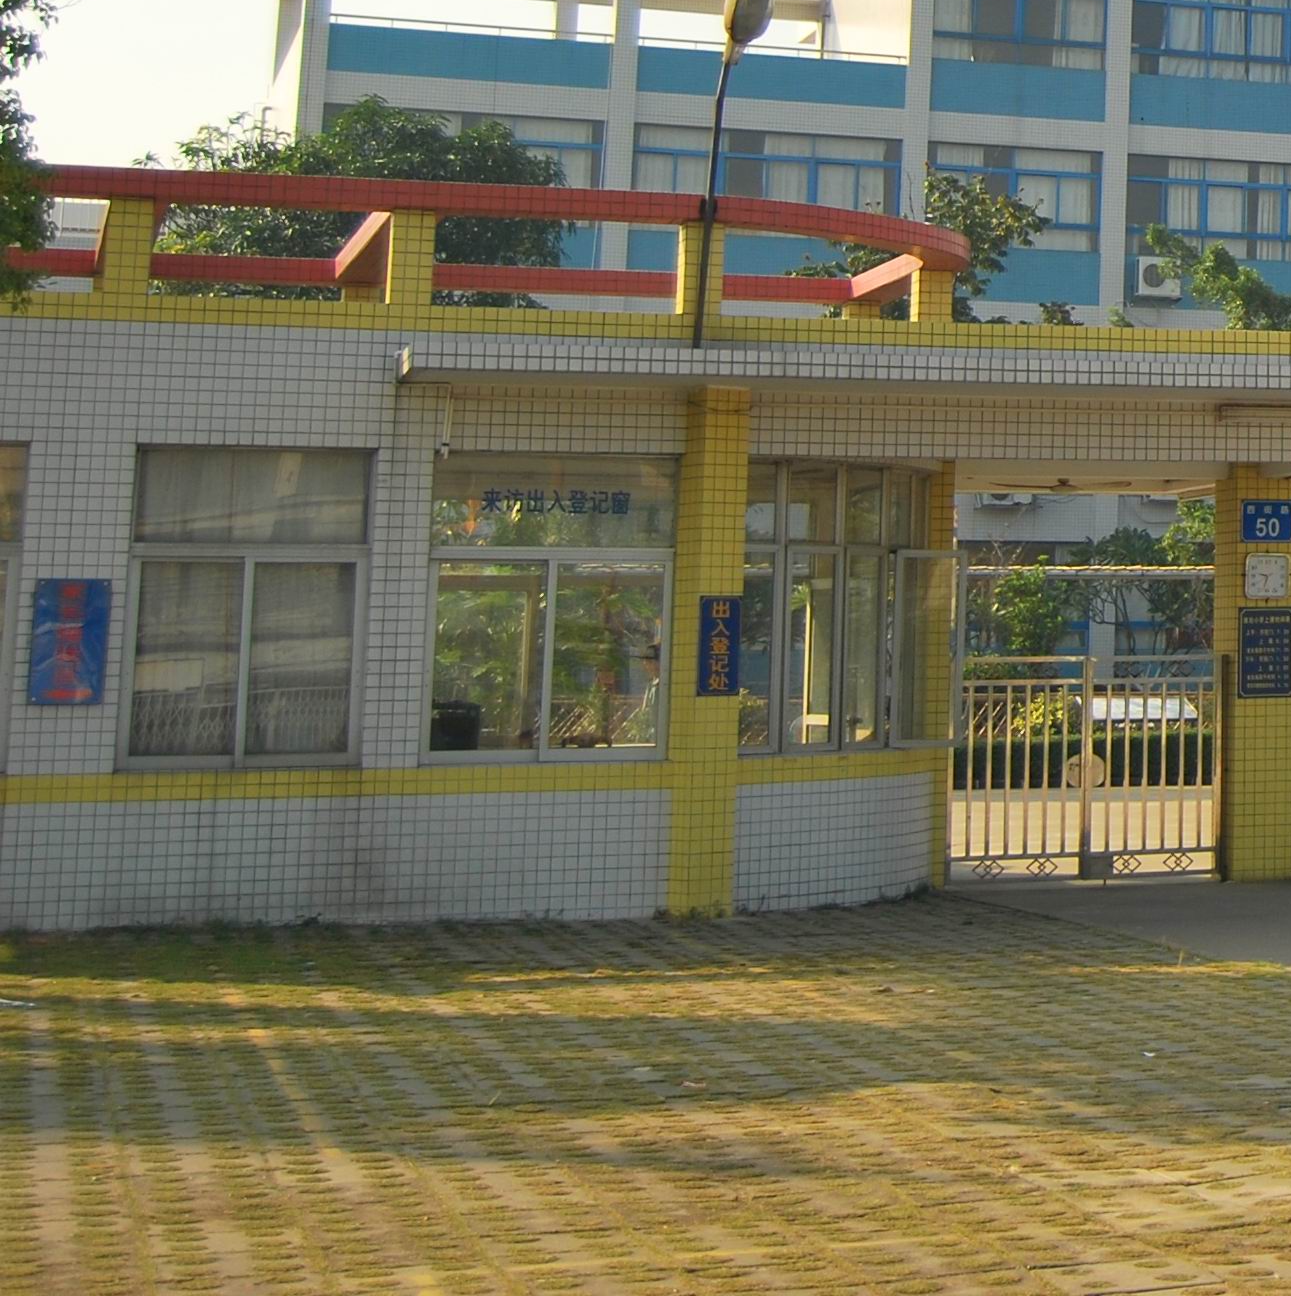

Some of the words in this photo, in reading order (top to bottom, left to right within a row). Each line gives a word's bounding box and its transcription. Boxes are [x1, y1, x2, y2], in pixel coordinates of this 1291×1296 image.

[480, 487, 632, 516] 来访出入登记窗
[1255, 518, 1280, 537] 50
[708, 598, 731, 691] 出入登记处
